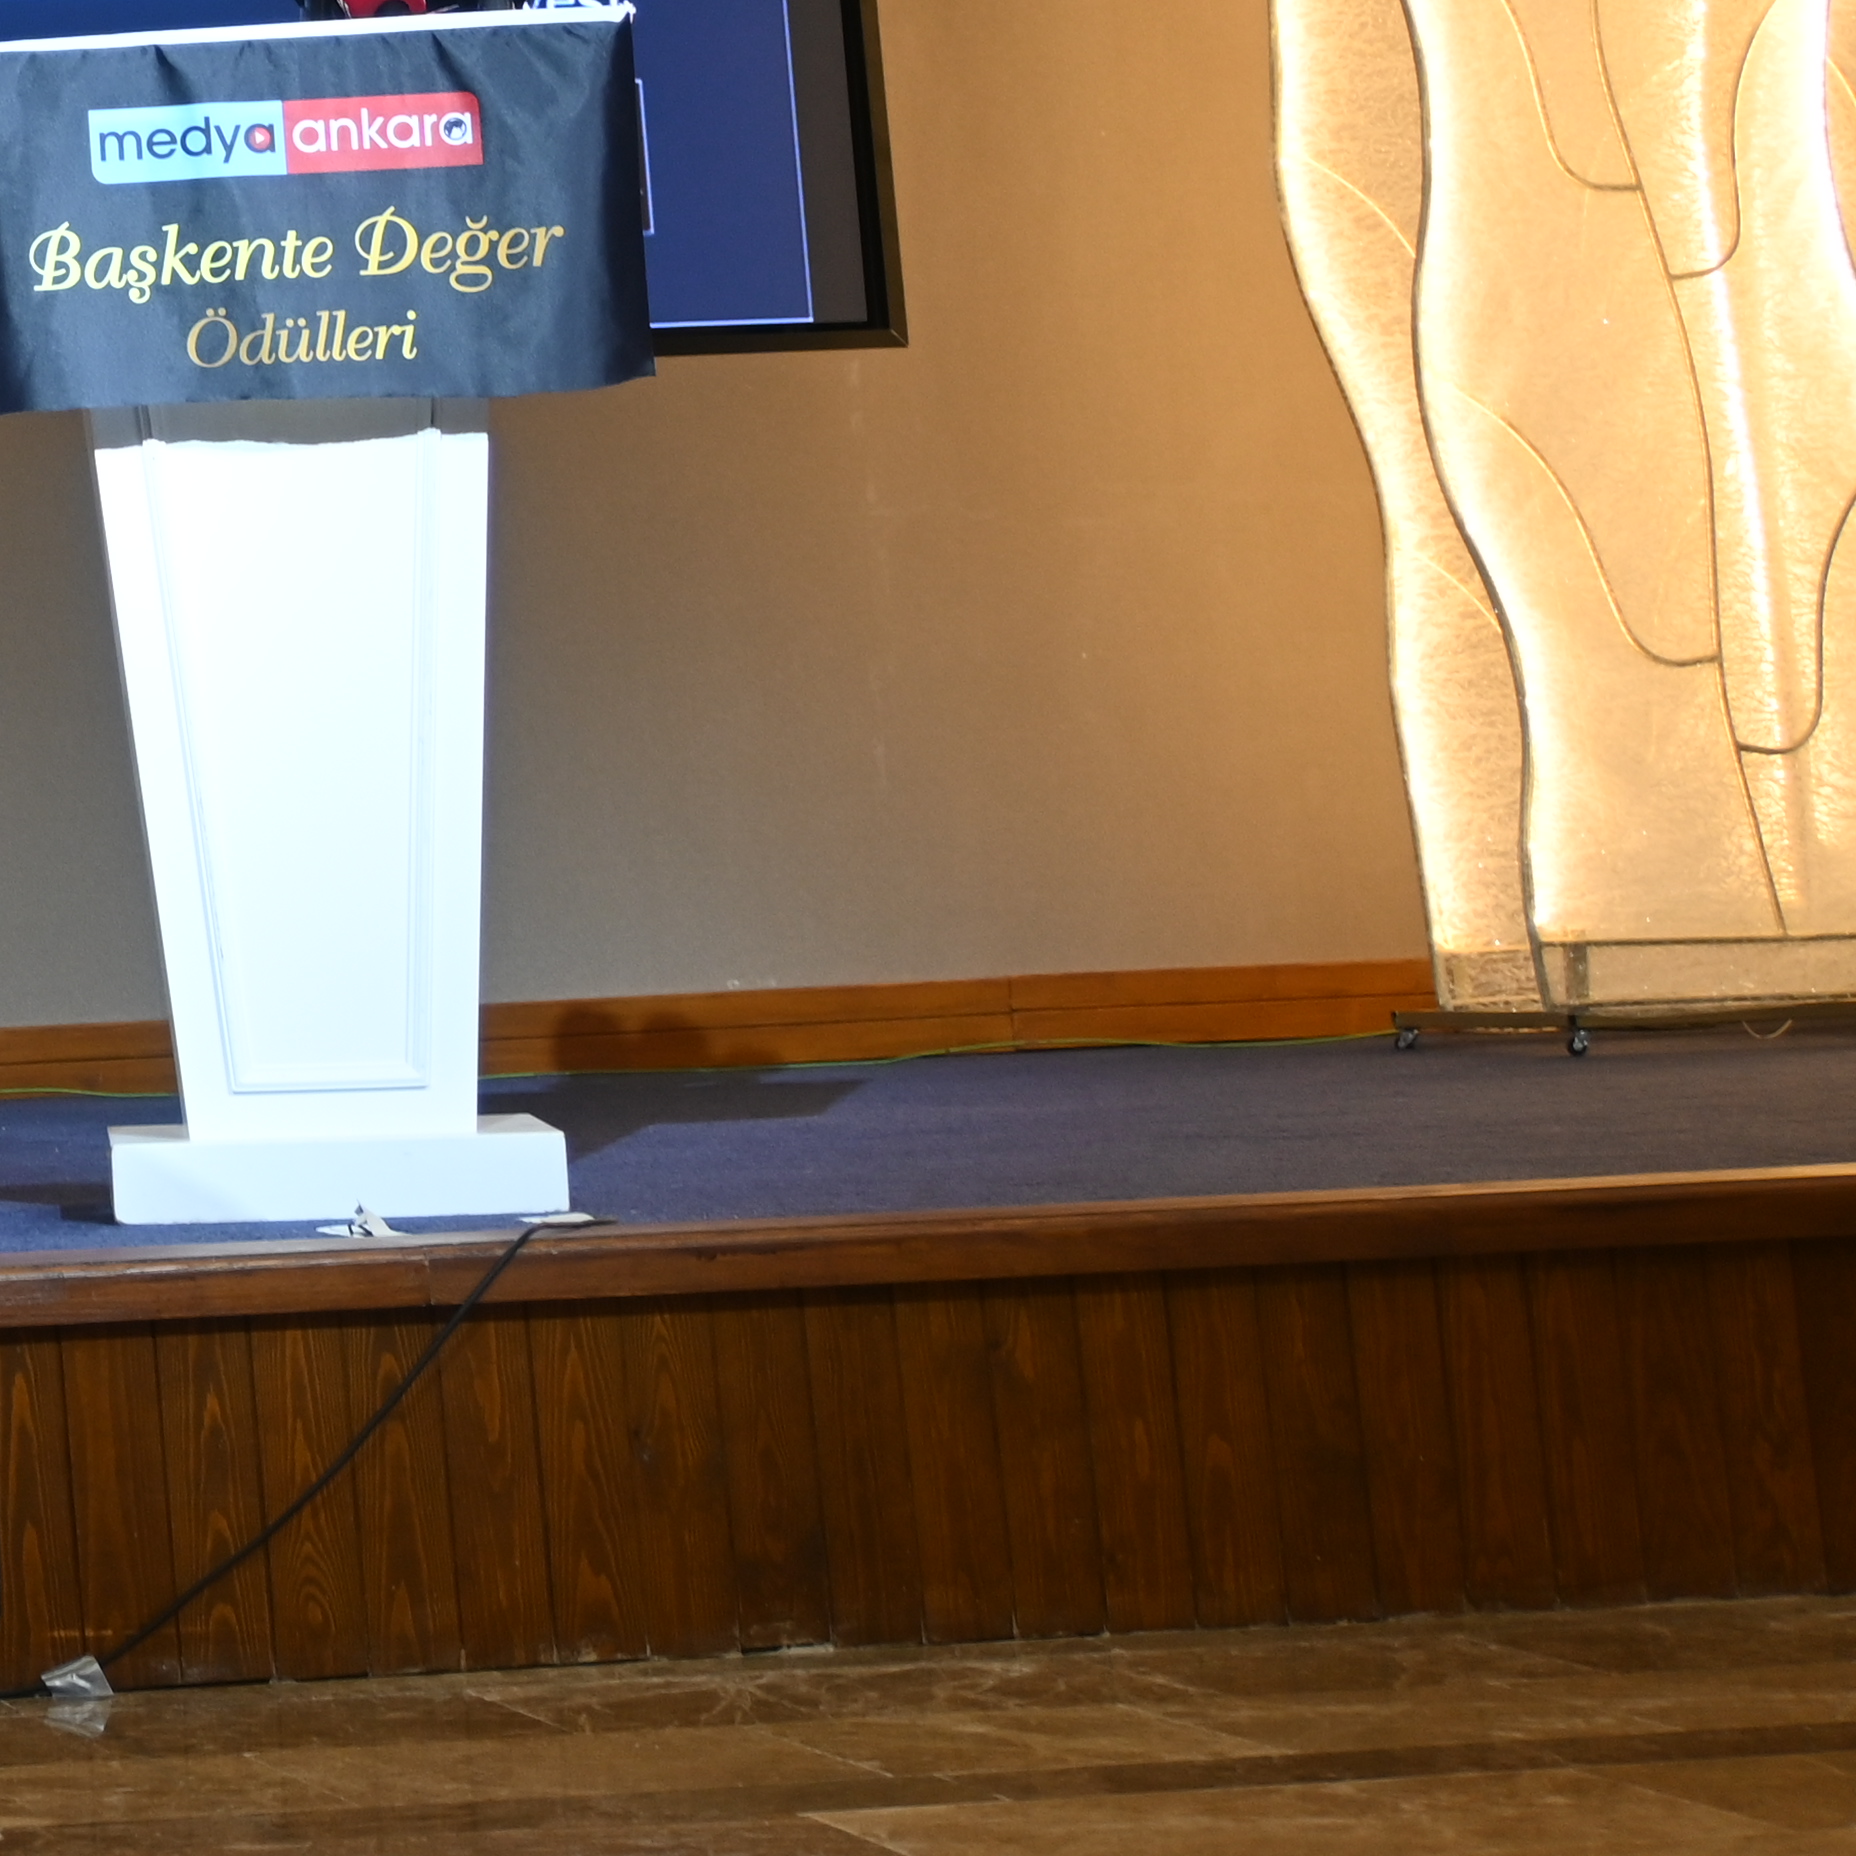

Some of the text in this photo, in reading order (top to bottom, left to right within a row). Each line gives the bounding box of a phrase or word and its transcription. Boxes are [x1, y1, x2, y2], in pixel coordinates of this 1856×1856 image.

[98, 107, 474, 164] medya ankara
[29, 205, 565, 304] Başkente Değer
[186, 307, 418, 368] Ödülleri
